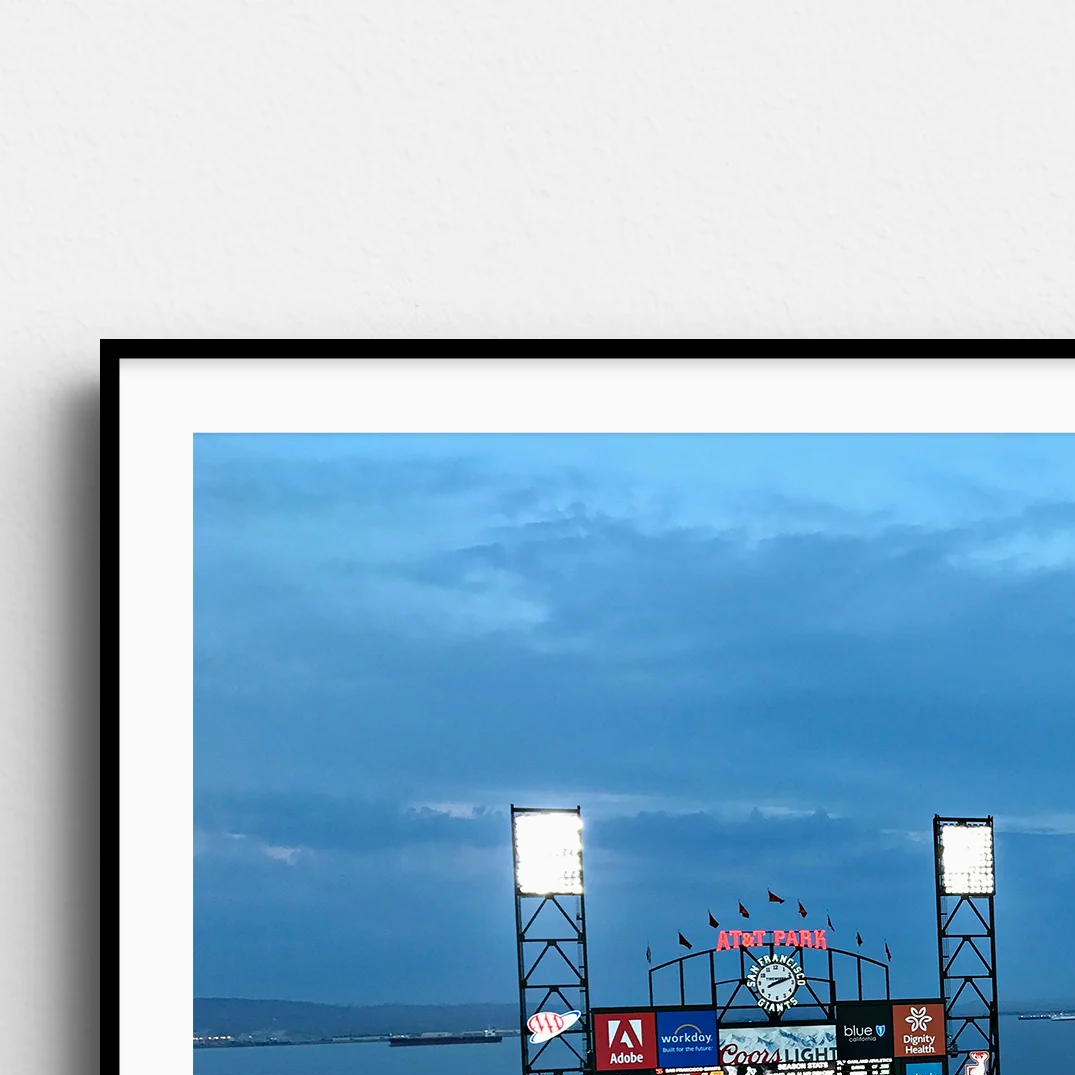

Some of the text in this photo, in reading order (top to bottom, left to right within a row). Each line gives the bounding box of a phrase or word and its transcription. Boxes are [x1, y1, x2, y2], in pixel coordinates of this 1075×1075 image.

[716, 929, 827, 952] AT&T PARK
[747, 953, 806, 988] SAN FRANCISCO
[757, 997, 798, 1012] GIANTS
[843, 1025, 873, 1037] blue
[849, 1035, 877, 1043] california
[903, 1034, 936, 1045] Dignity
[720, 1043, 838, 1065] Coors LIGHT
[905, 1045, 935, 1054] Health
[610, 1052, 644, 1065] Adobe
[777, 1062, 806, 1070] SEASON
